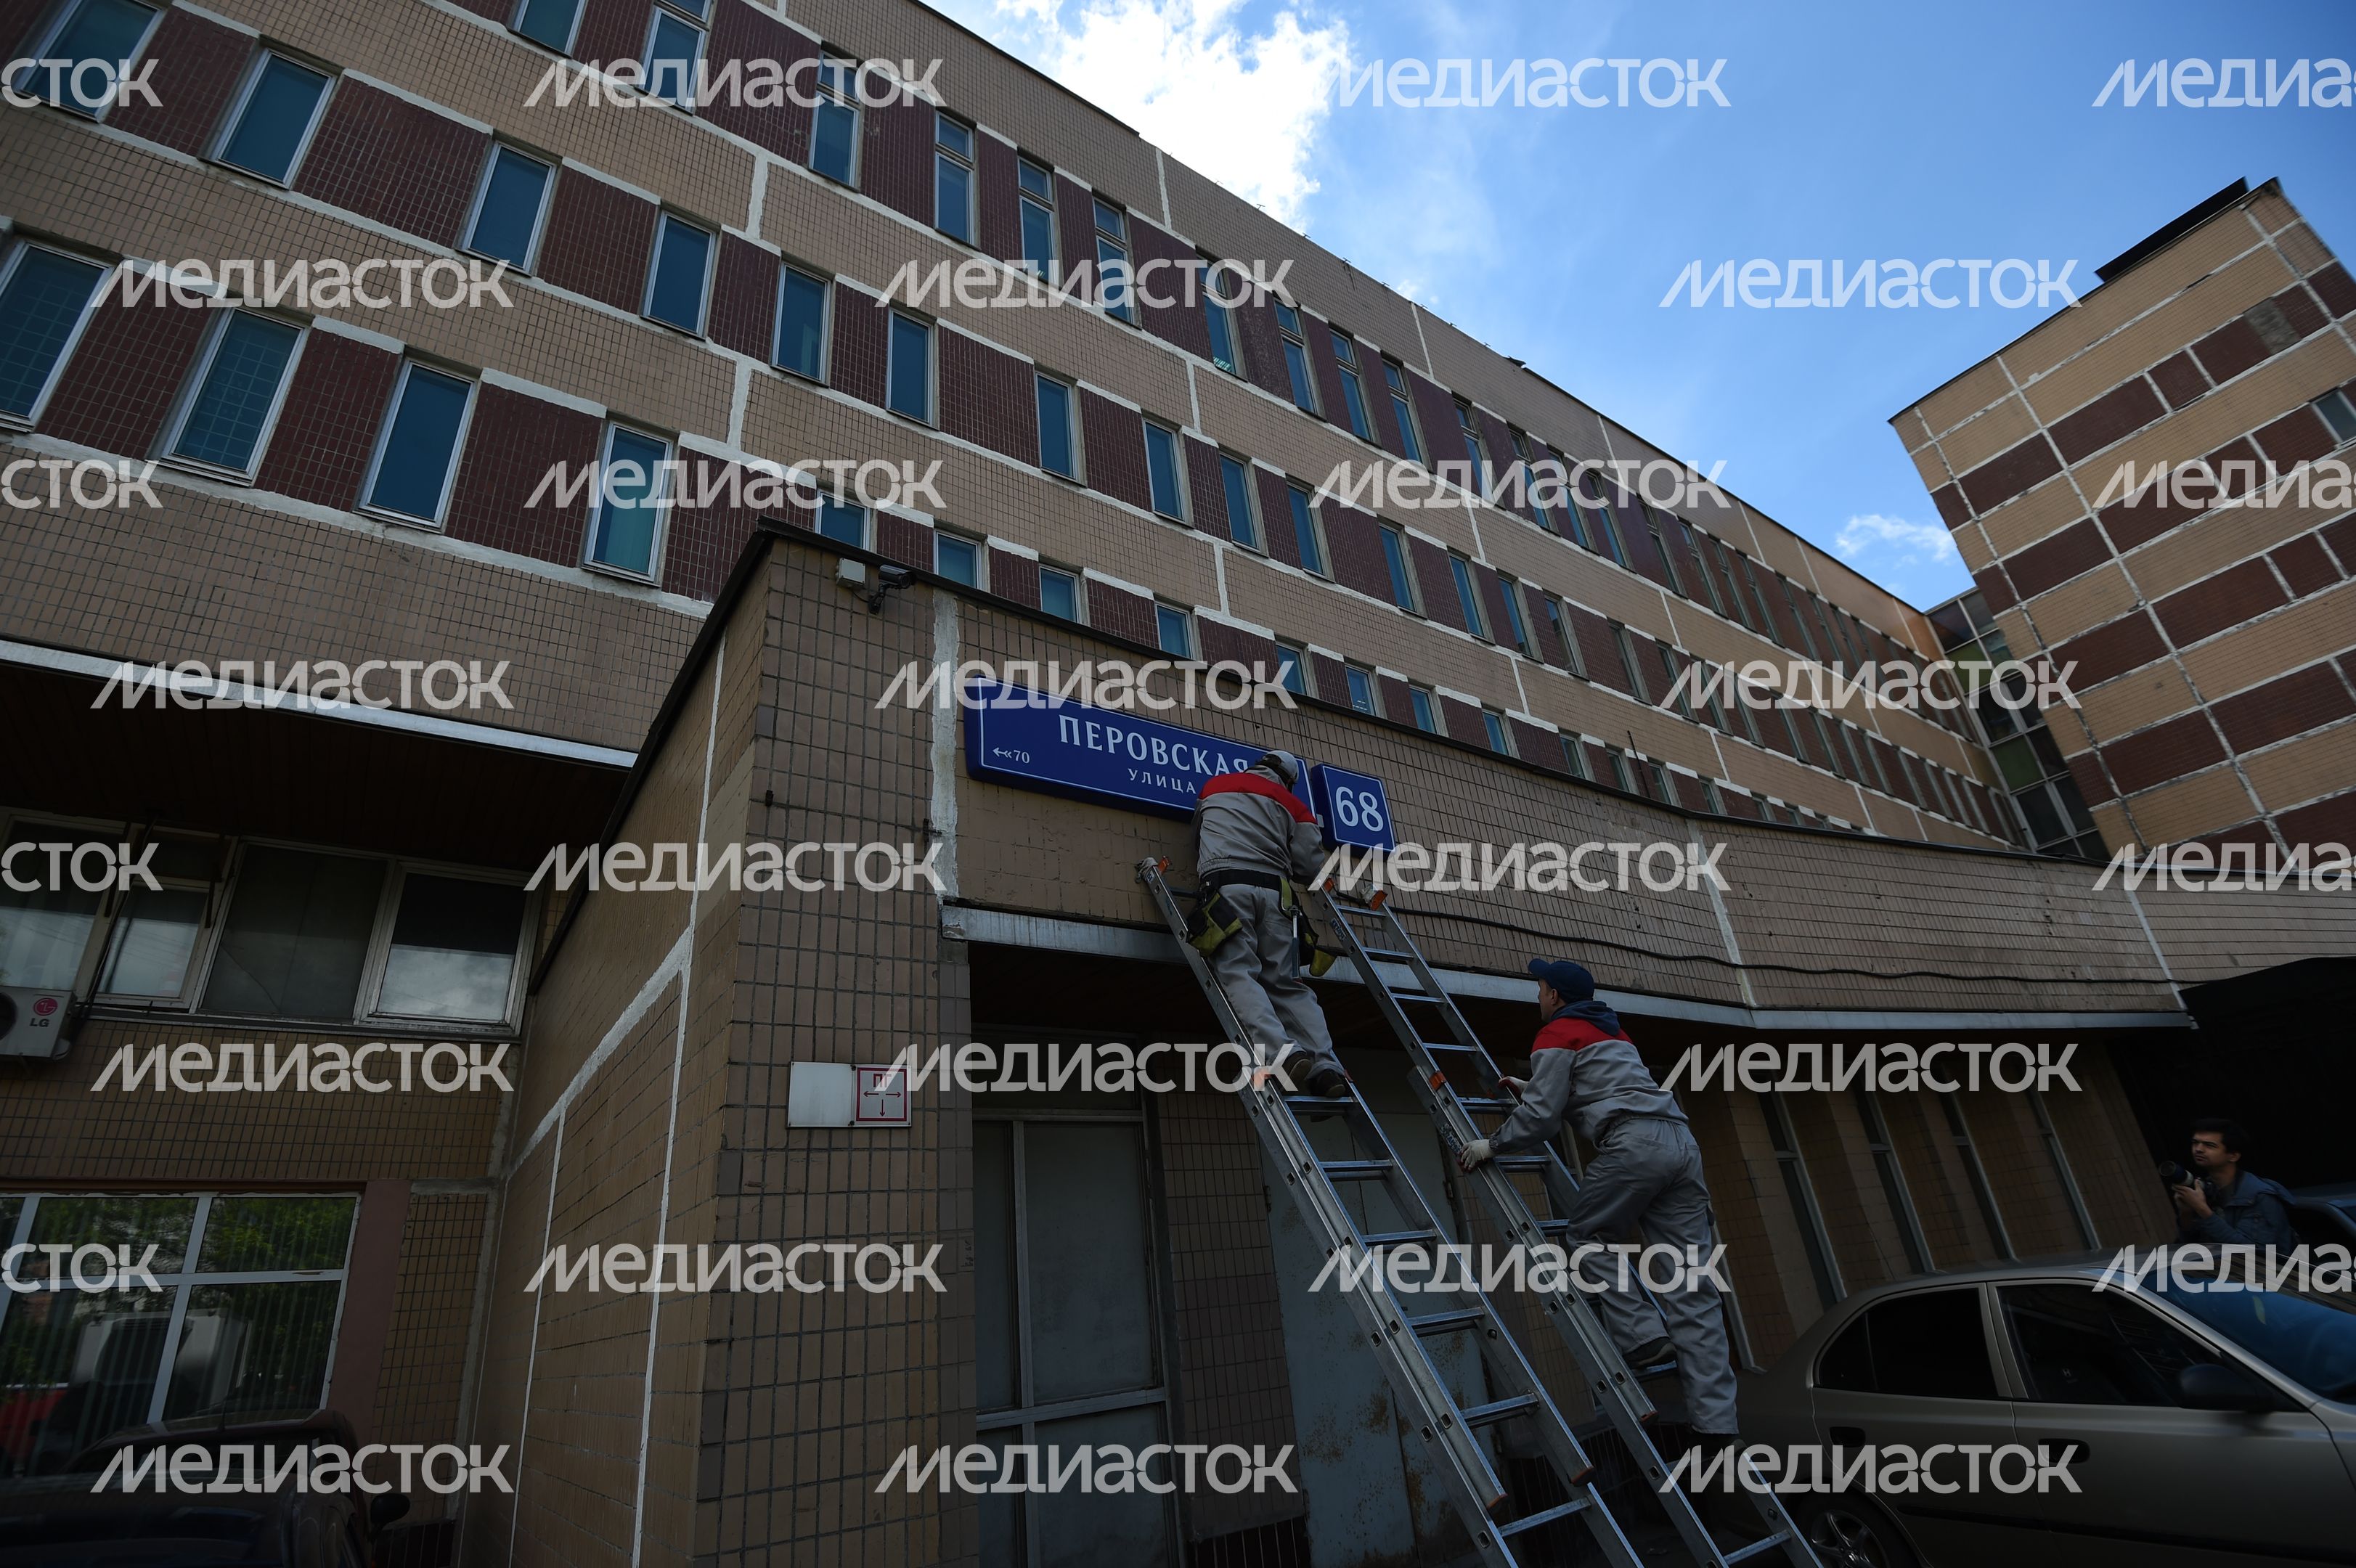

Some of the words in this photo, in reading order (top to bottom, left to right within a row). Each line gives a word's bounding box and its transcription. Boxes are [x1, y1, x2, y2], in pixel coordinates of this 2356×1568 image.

[1014, 749, 1030, 764] 70
[1128, 767, 1197, 795] УЛИЦА
[1336, 786, 1384, 832] 68
[29, 1018, 50, 1028] LG
